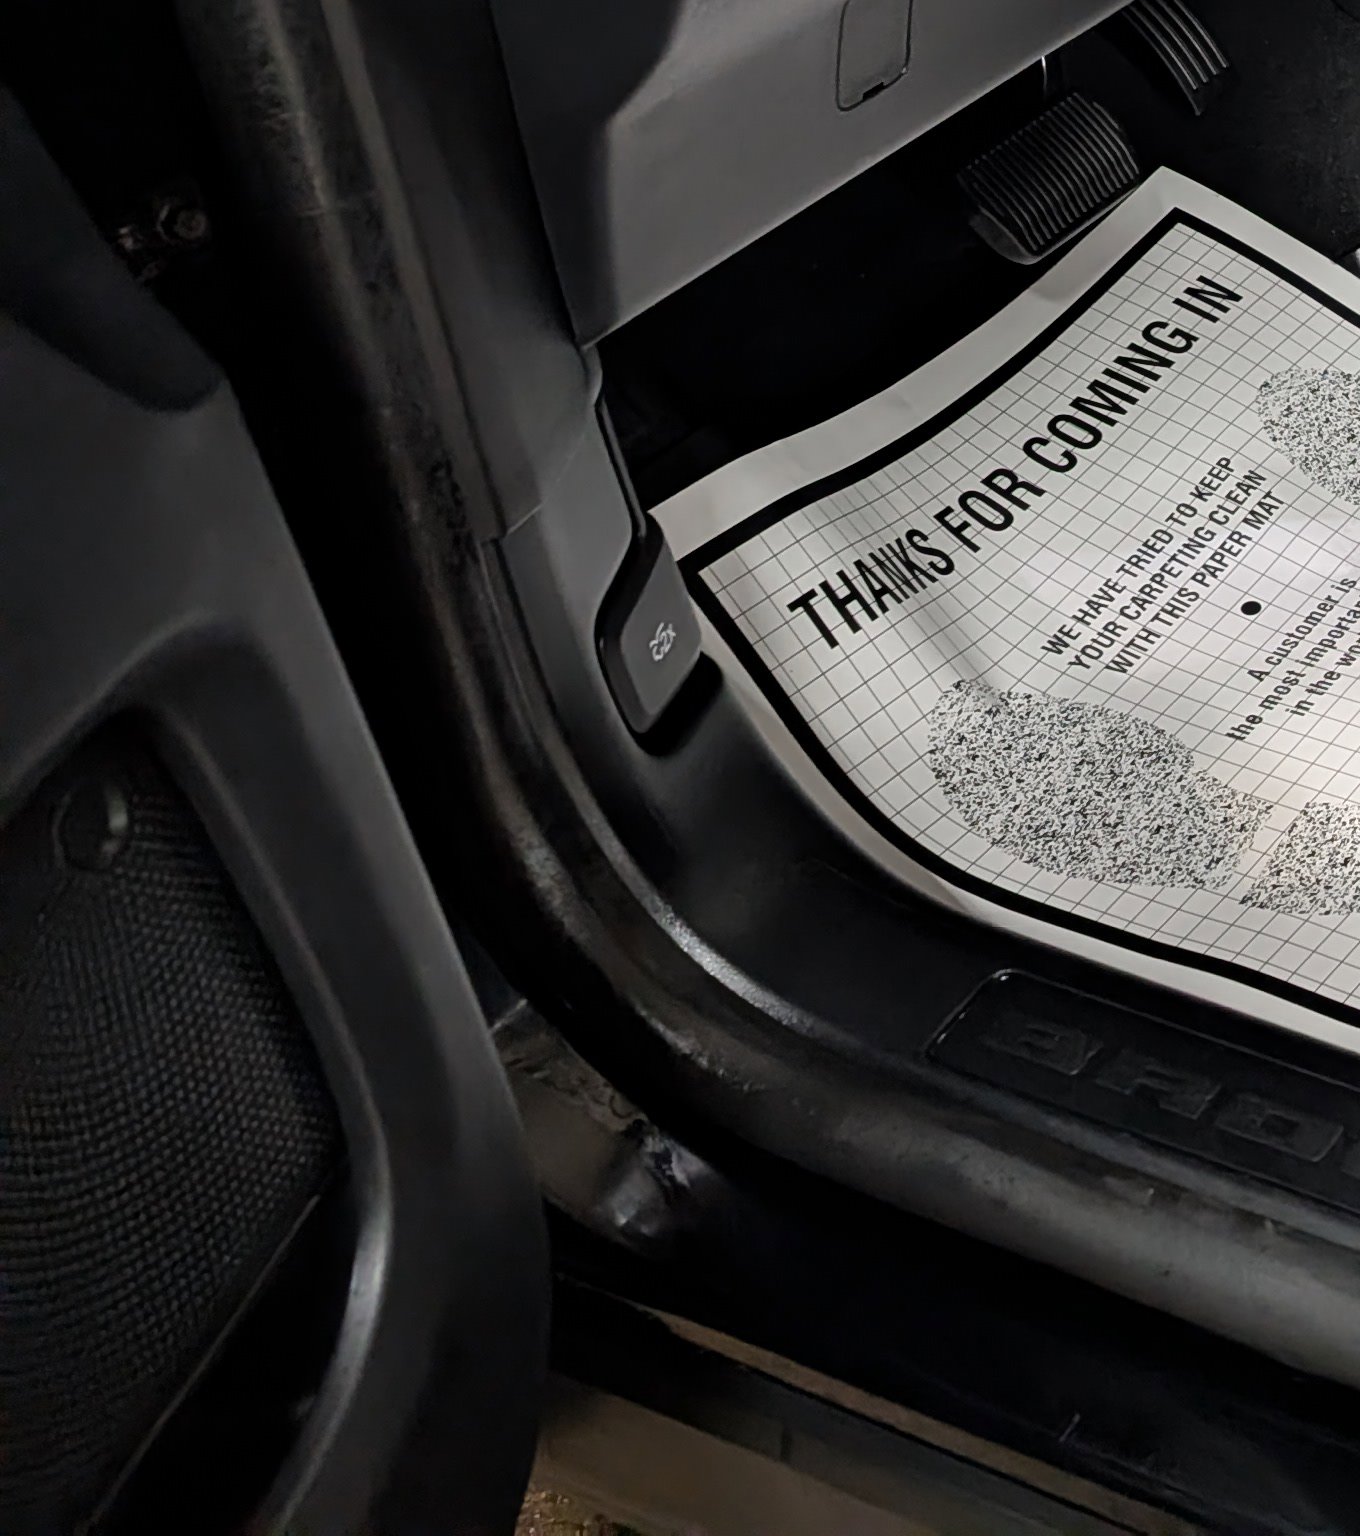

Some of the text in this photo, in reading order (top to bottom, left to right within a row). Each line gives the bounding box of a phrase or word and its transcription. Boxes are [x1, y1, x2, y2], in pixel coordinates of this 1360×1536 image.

[786, 274, 1244, 649] THANKS FOR COMING IN
[1040, 456, 1235, 655] WE HAVE TRIED TO KEEP
[1068, 469, 1267, 670] YOUR CARPETING CLEAN
[1104, 490, 1285, 675] WITH THIS PAPER MAT
[1247, 577, 1357, 682] A customer is
[1225, 714, 1263, 741] the
[1258, 670, 1306, 711] most
[1285, 699, 1315, 716] in
[1305, 670, 1341, 696] the
